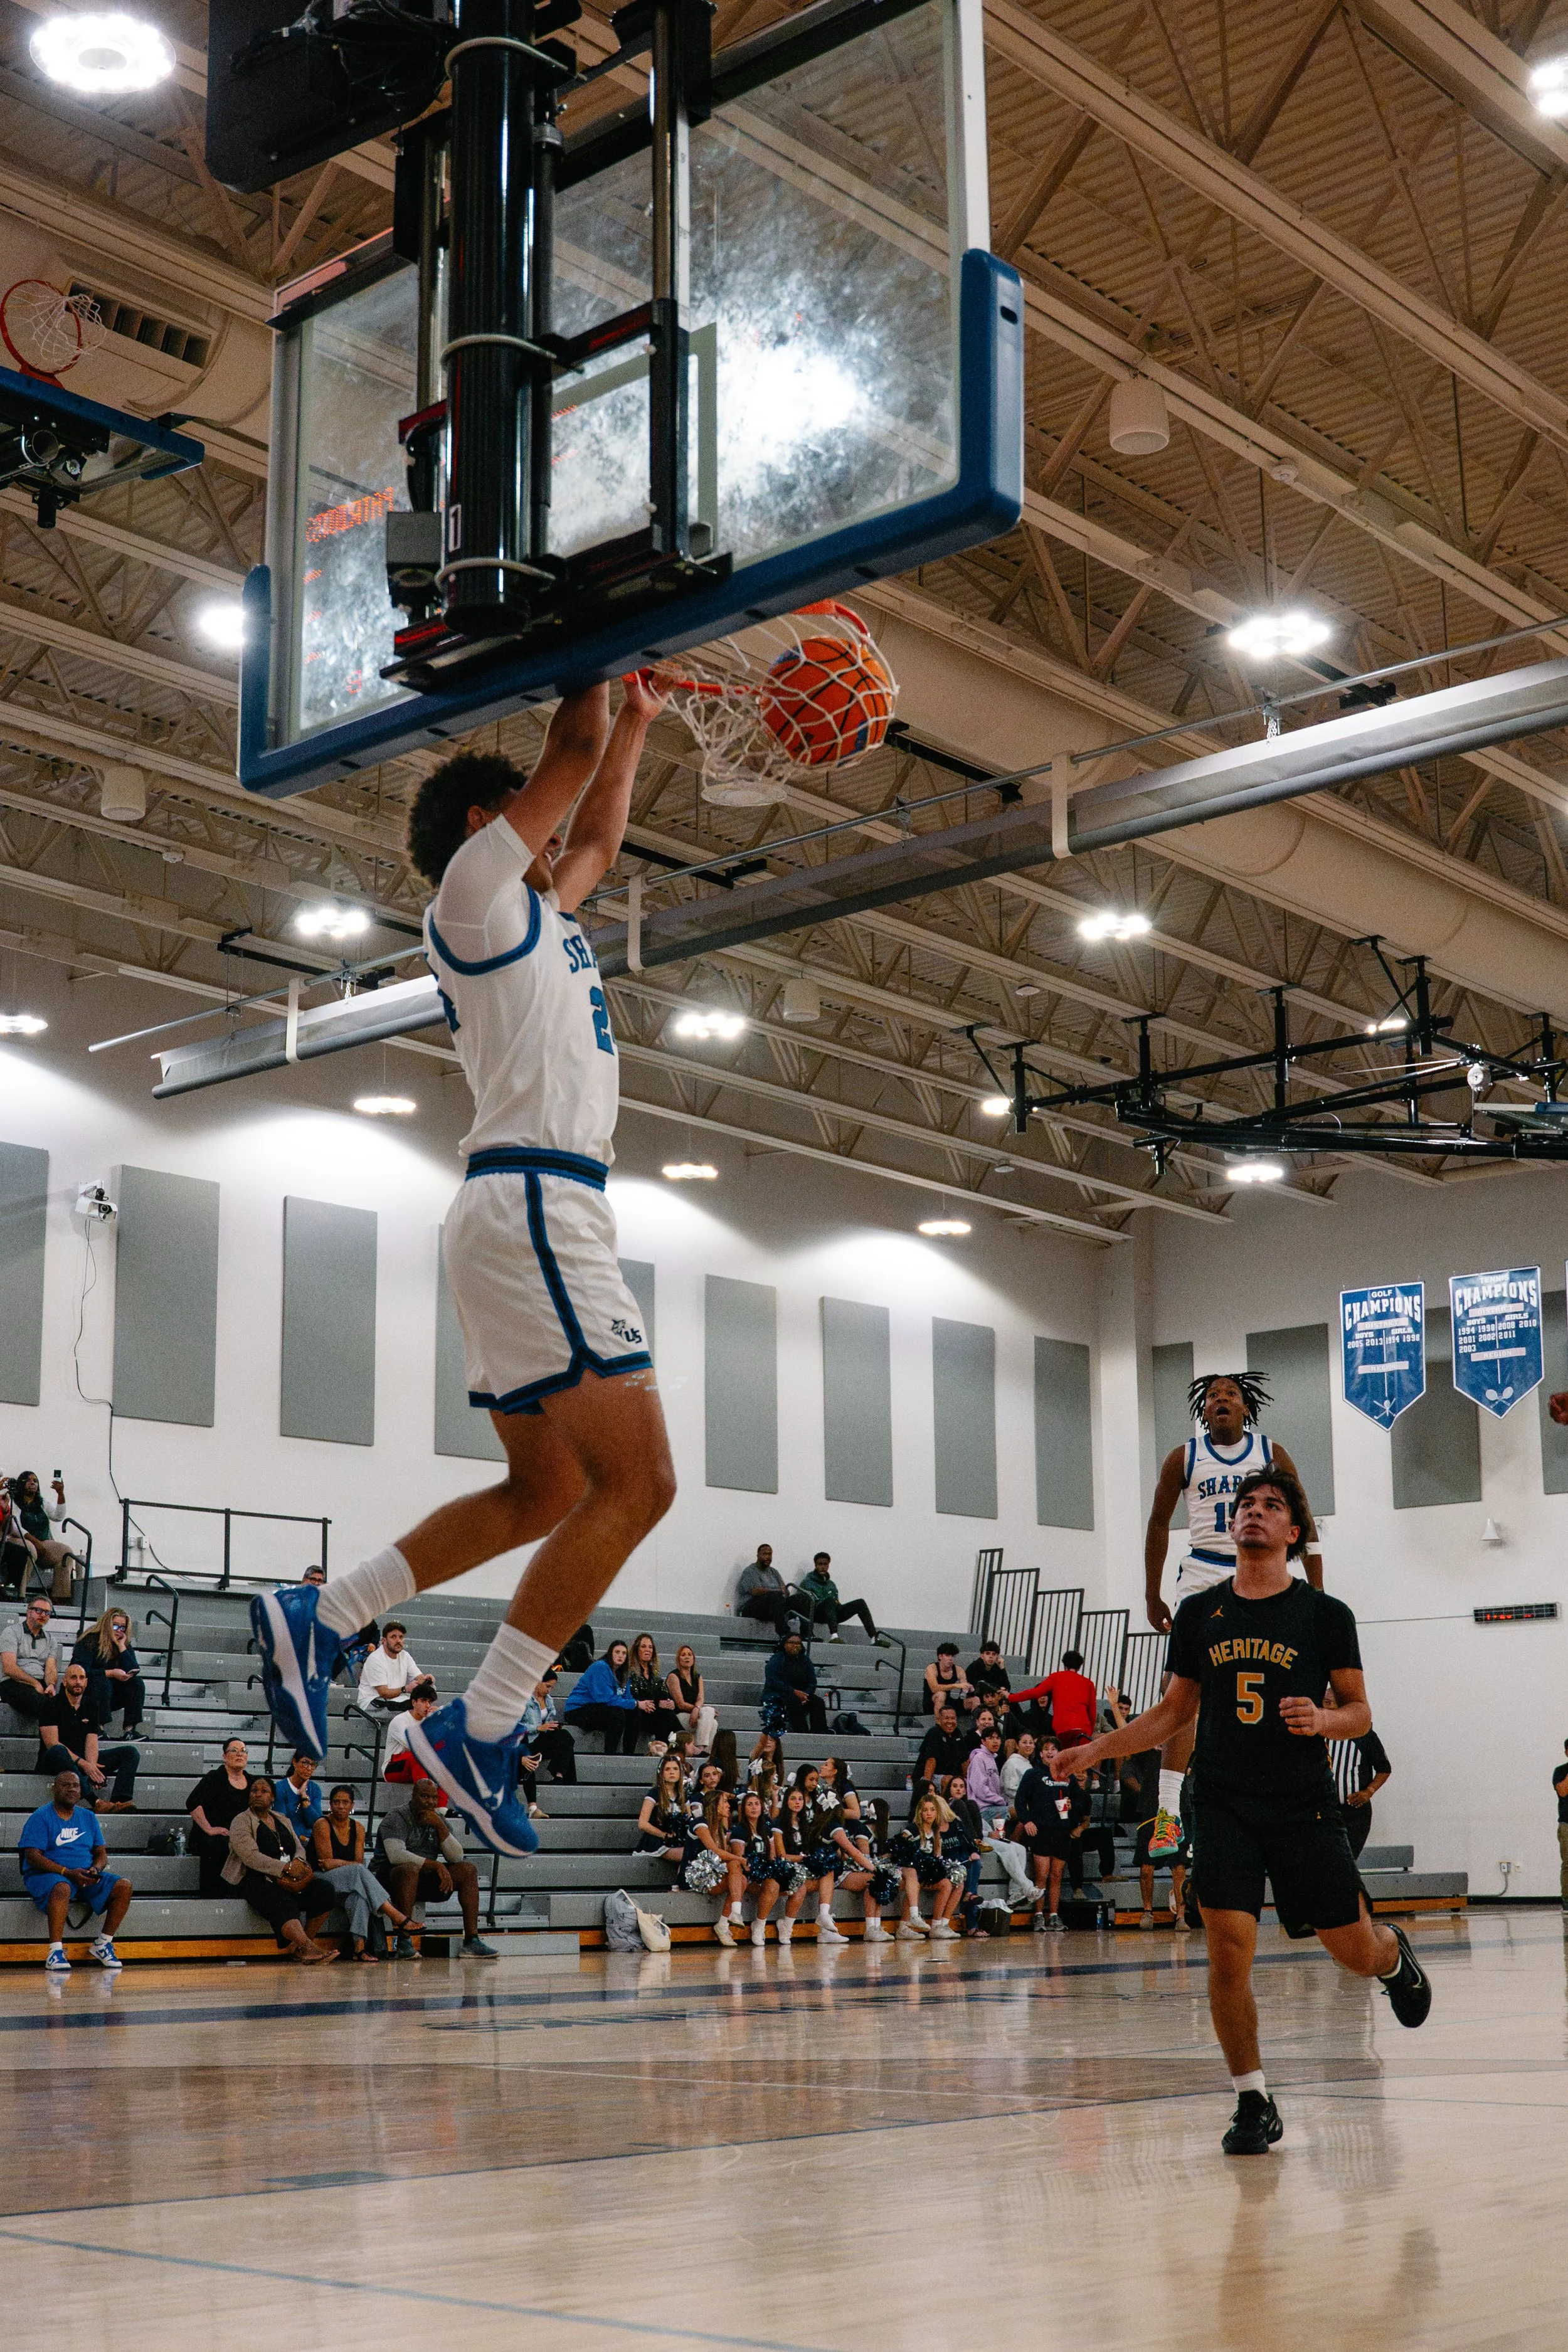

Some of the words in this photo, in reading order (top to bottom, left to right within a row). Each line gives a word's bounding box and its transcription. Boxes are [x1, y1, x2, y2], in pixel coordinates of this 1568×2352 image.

[590, 985, 615, 1056] 2
[1479, 1274, 1509, 1284] TENNIS
[1371, 1290, 1392, 1298] GOLF
[1455, 1280, 1537, 1317] CHAMPIONS
[1345, 1295, 1421, 1331] CHAMPIONS
[1478, 1305, 1514, 1315] DISTRICT
[1365, 1320, 1399, 1328] DISTRICT
[1466, 1318, 1486, 1326] BOYS
[1505, 1313, 1529, 1321] GIRLS
[1498, 1322, 1515, 1330] 2008
[1518, 1319, 1537, 1328] 2010
[1458, 1327, 1475, 1336] 1994
[1478, 1323, 1495, 1333] 1998
[1498, 1330, 1516, 1339] 2011
[1355, 1332, 1374, 1340] BOYS
[1385, 1336, 1400, 1345] 1994
[1402, 1334, 1420, 1342] 1998
[1458, 1336, 1475, 1345] 2001
[1478, 1333, 1496, 1342] 2002
[1347, 1340, 1363, 1348] 2005
[1365, 1337, 1383, 1347] 2013
[1459, 1344, 1476, 1353] 2003
[1483, 1349, 1512, 1359] REGION
[1370, 1364, 1396, 1372] REGION
[1197, 1475, 1245, 1500] SHAR
[1214, 1502, 1235, 1532] 1
[1209, 1638, 1298, 1670] HERITAGE
[1236, 1671, 1264, 1724] 5
[60, 1827, 79, 1839] NIKE
